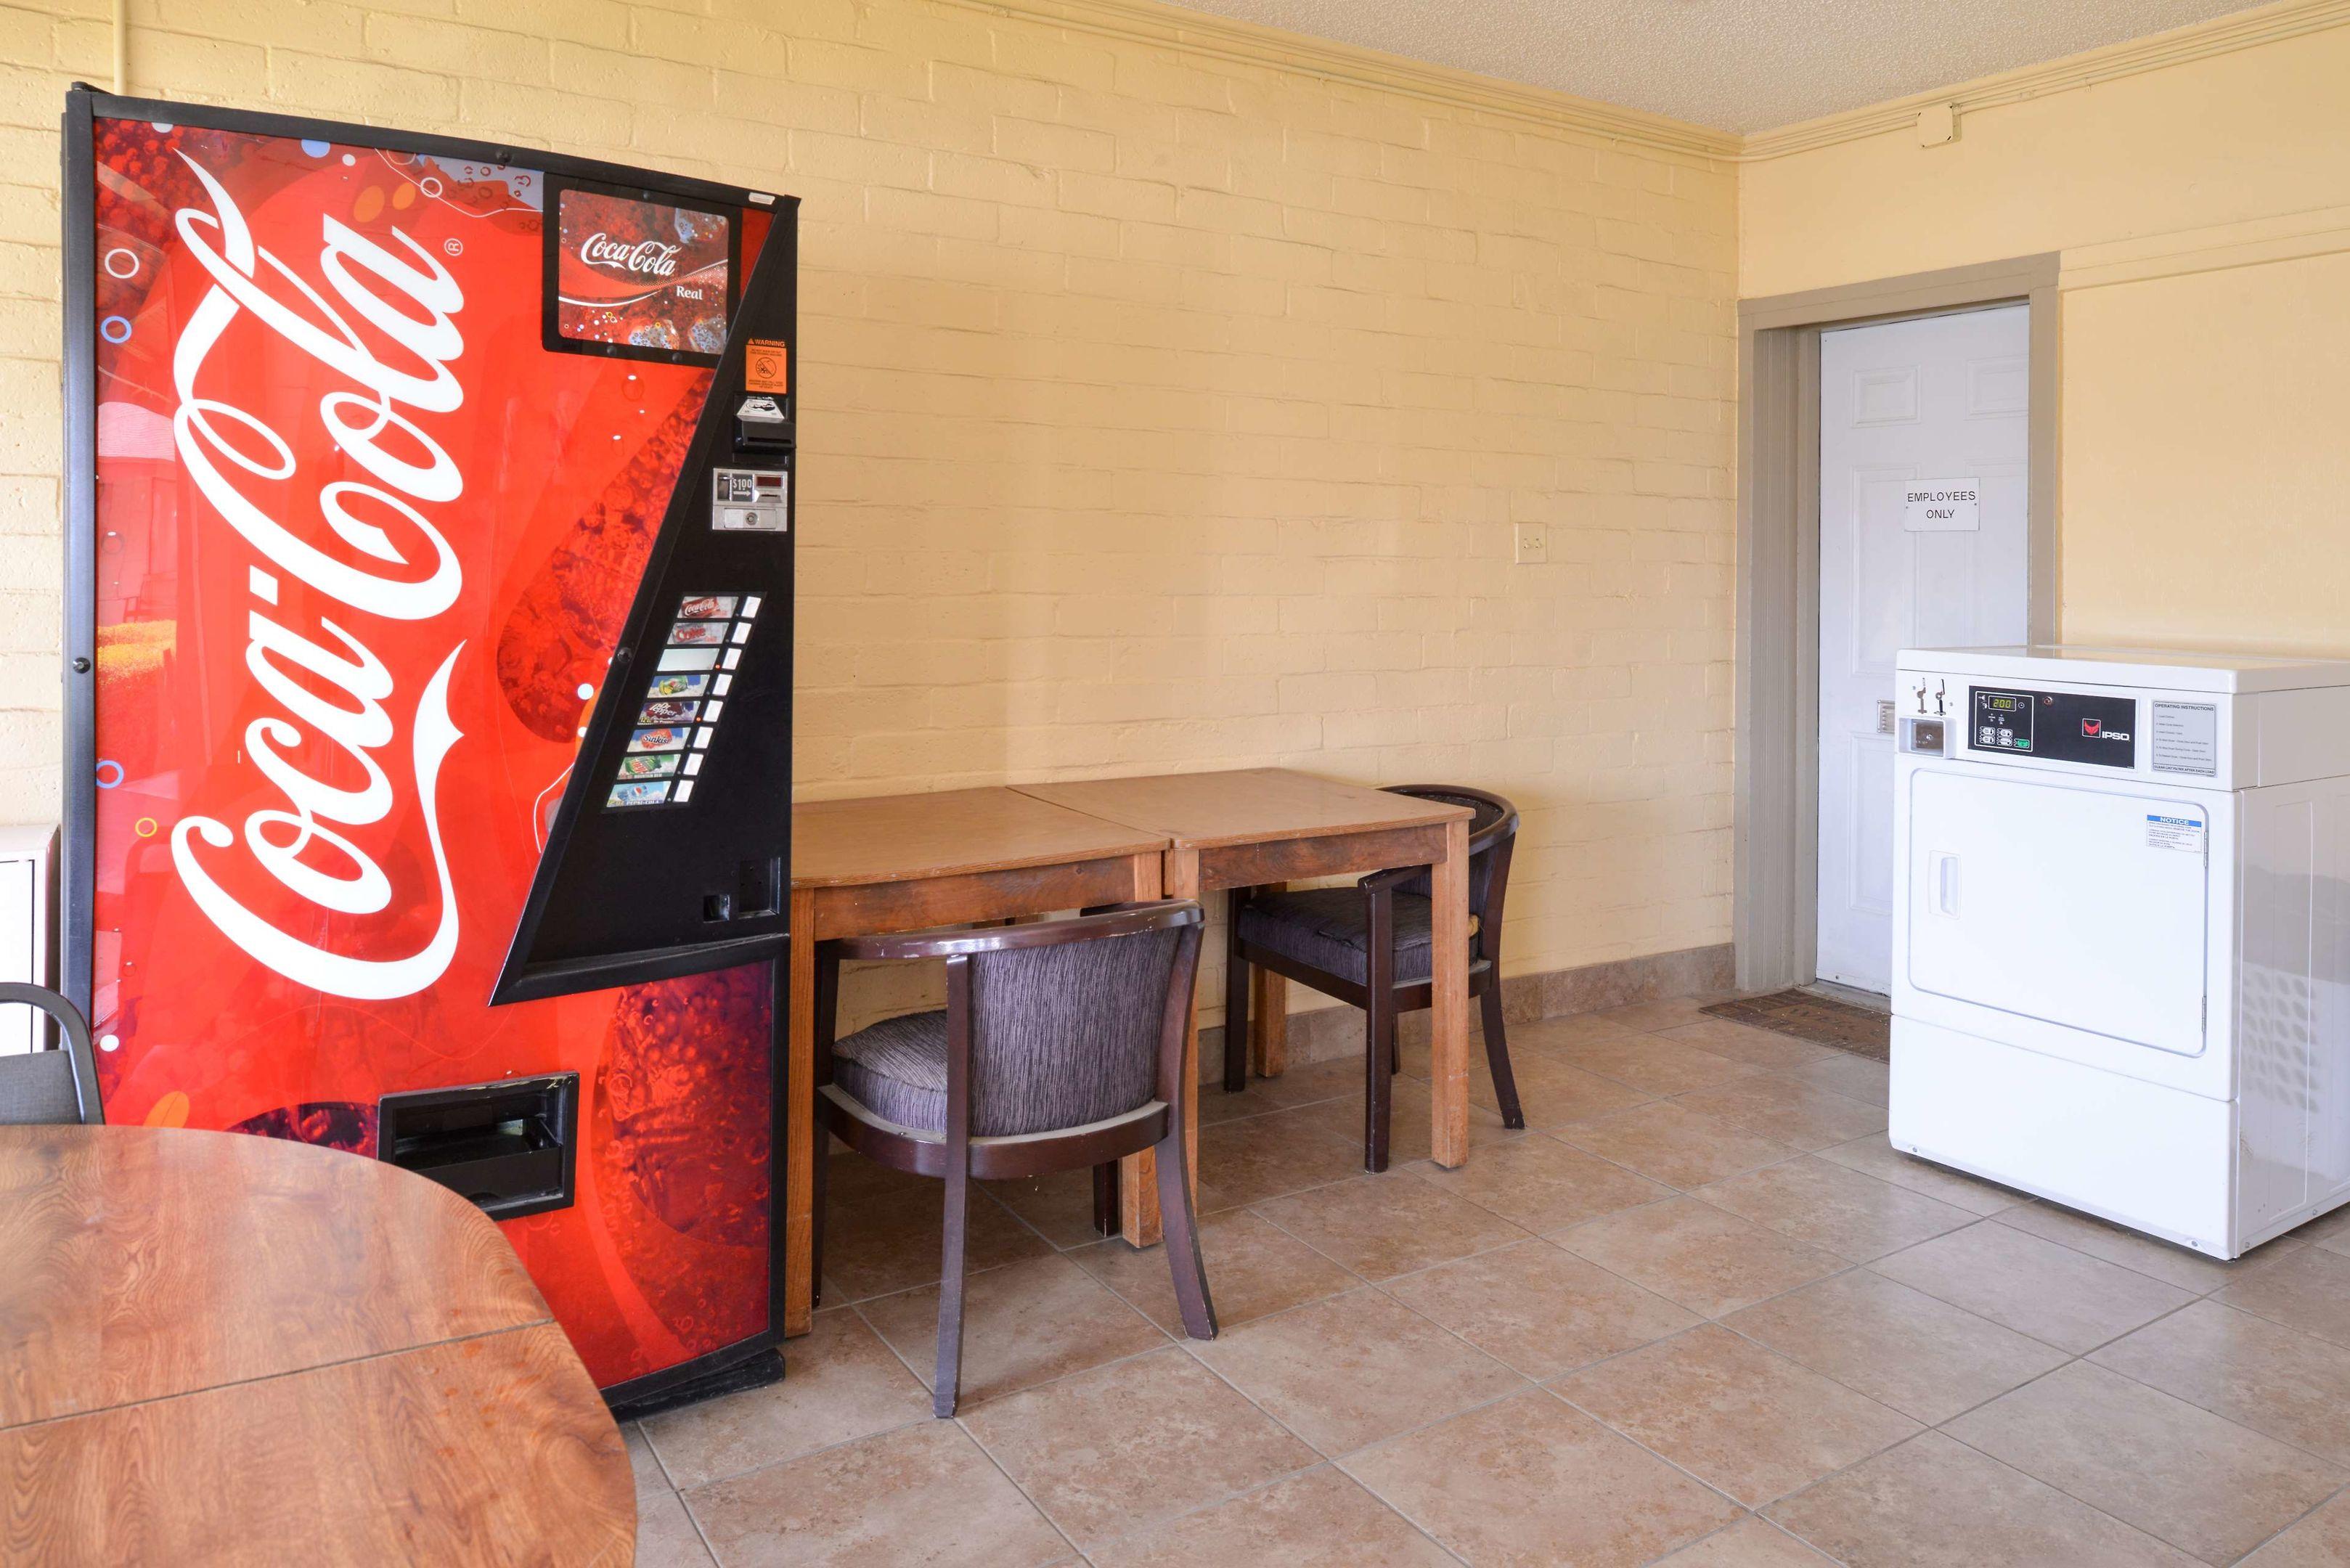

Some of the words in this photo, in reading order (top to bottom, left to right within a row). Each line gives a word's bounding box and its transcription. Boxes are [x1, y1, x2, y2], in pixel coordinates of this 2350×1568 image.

[581, 232, 682, 277] Coca-Cola
[676, 285, 703, 300] Real
[1907, 491, 1976, 502] EMPLOYEES
[1926, 509, 1954, 519] ONLY
[1993, 699, 2011, 709] 200
[2102, 730, 2130, 741] IPSO
[2160, 817, 2190, 825] NOTICE
